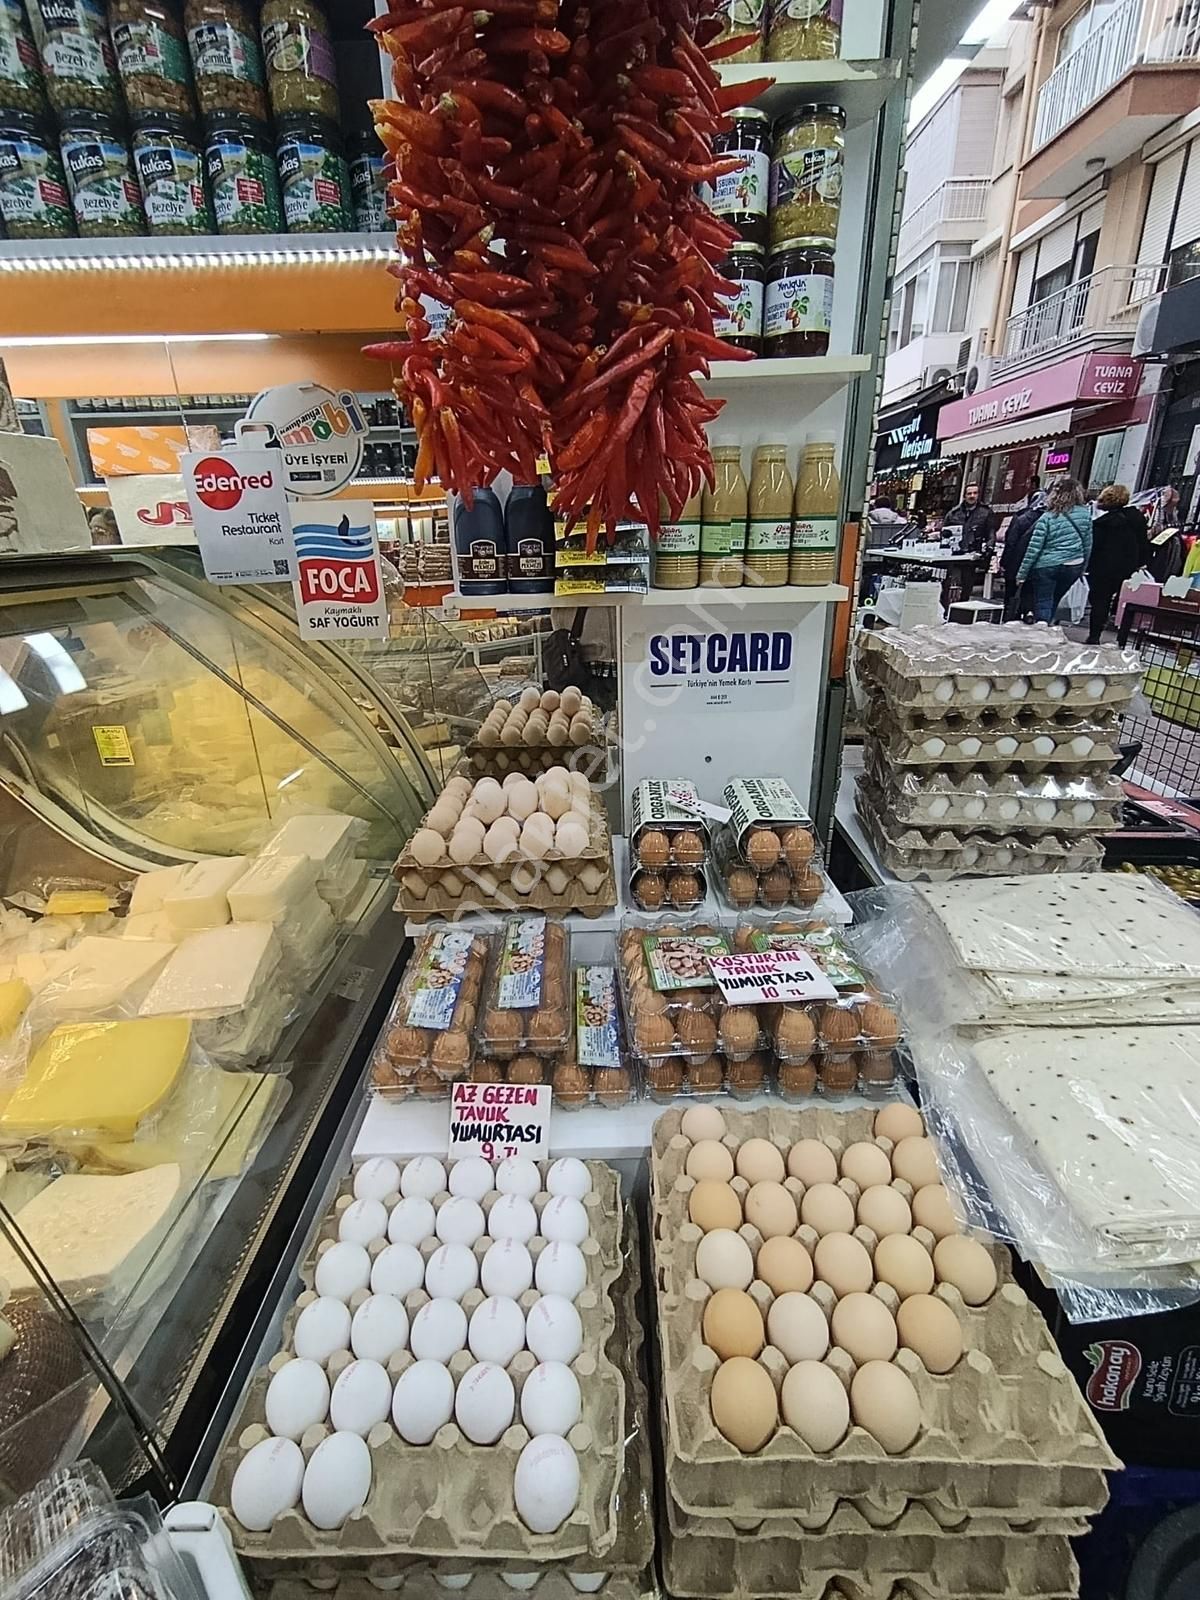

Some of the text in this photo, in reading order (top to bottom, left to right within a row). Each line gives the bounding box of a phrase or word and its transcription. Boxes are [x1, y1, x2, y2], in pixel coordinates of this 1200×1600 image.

[54, 50, 96, 70] Bezelye
[83, 197, 119, 212] Bezelye
[152, 200, 185, 214] Bezelye
[1095, 366, 1133, 378] TUANA
[1094, 380, 1124, 396] ÇEYİZ
[968, 388, 1033, 426] TUANA ÇEYİZ
[283, 394, 363, 445] mobi
[284, 451, 349, 467] ÜYE İŞYERİ
[194, 470, 273, 493] Edenred
[247, 512, 280, 524] Ticket
[221, 524, 282, 536] Restaurant
[269, 537, 285, 545] Kart
[306, 566, 372, 598] FOÇA
[324, 606, 362, 616] Kaymaklı
[309, 615, 380, 629] SAF YOĞURT
[649, 632, 793, 676] SETCARD
[687, 678, 752, 688] Türkiye'nin Yemek Kartı
[651, 780, 665, 820] ORGANİK
[741, 778, 773, 818] ORGANİK
[723, 784, 750, 832] ORGANİK
[709, 950, 801, 969] KOŞTURAN
[721, 964, 782, 976] TAVUK
[718, 971, 815, 991] YUMURTASI
[761, 986, 805, 999] 10 TL
[453, 1084, 538, 1106] AZ GEZEN
[455, 1105, 510, 1123] TAVUK
[451, 1121, 542, 1144] YUMURTASI
[1096, 1346, 1131, 1406] hakanay
